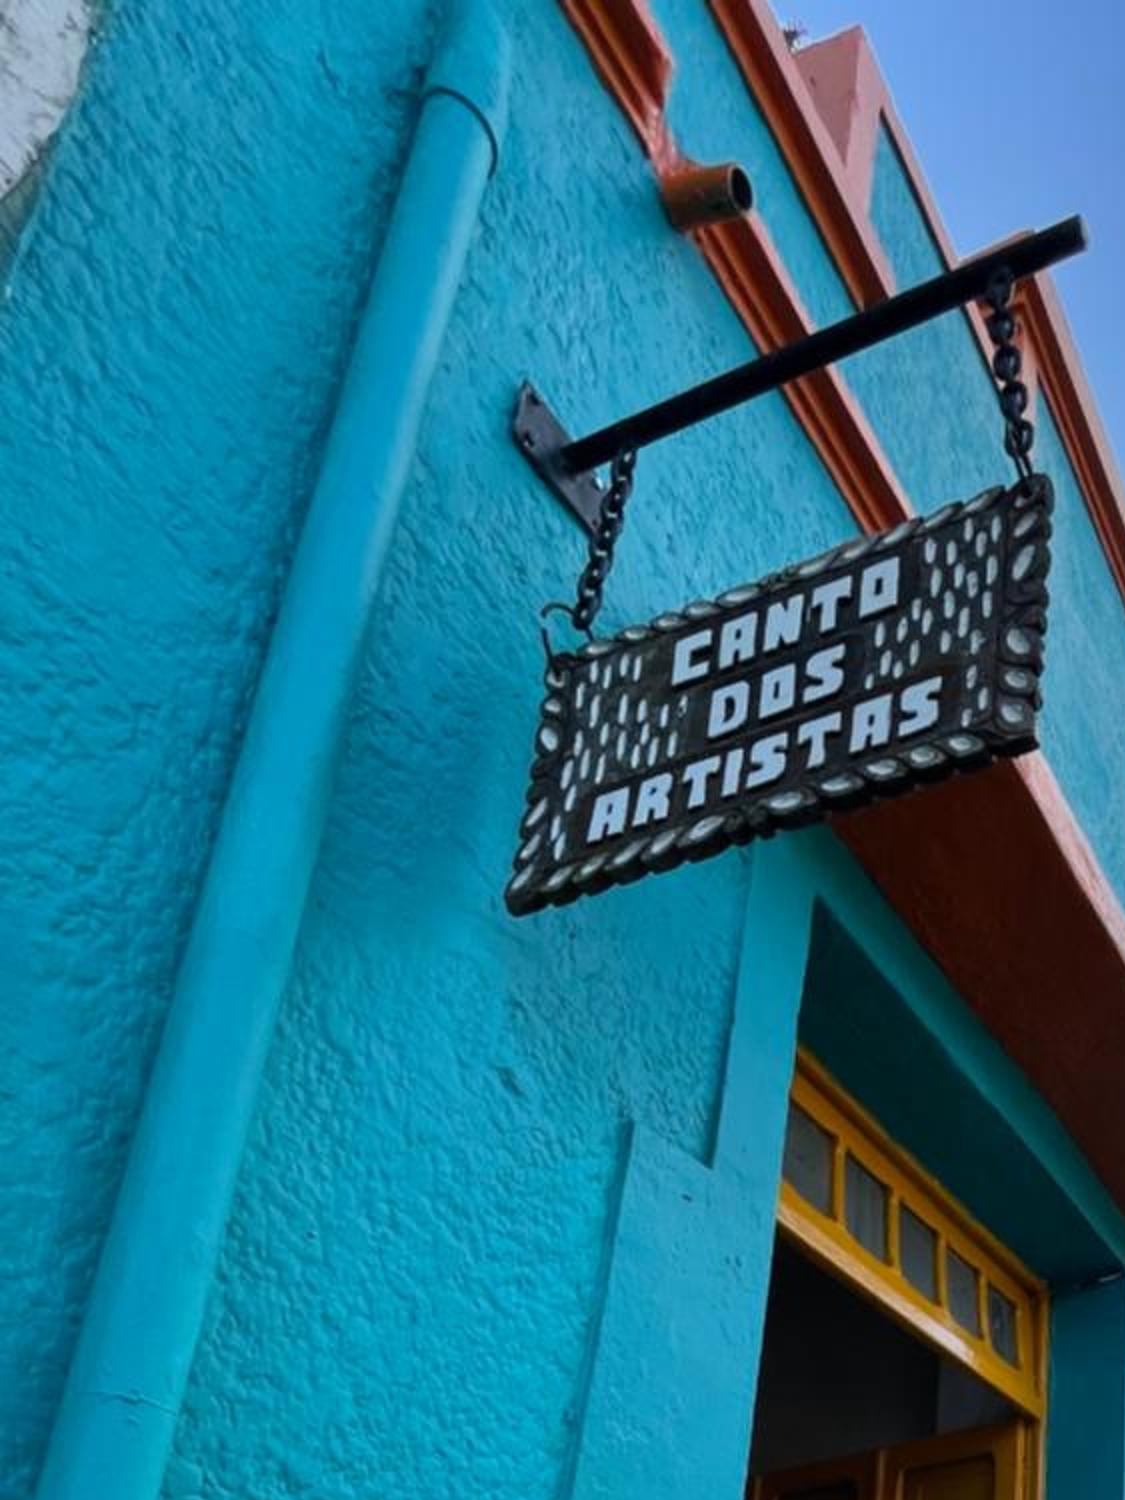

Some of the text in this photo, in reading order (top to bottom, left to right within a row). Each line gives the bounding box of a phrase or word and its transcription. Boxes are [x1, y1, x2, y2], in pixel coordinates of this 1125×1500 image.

[671, 556, 900, 687] CANTO
[707, 643, 846, 739] DOS
[587, 675, 943, 844] ARTISTAS
